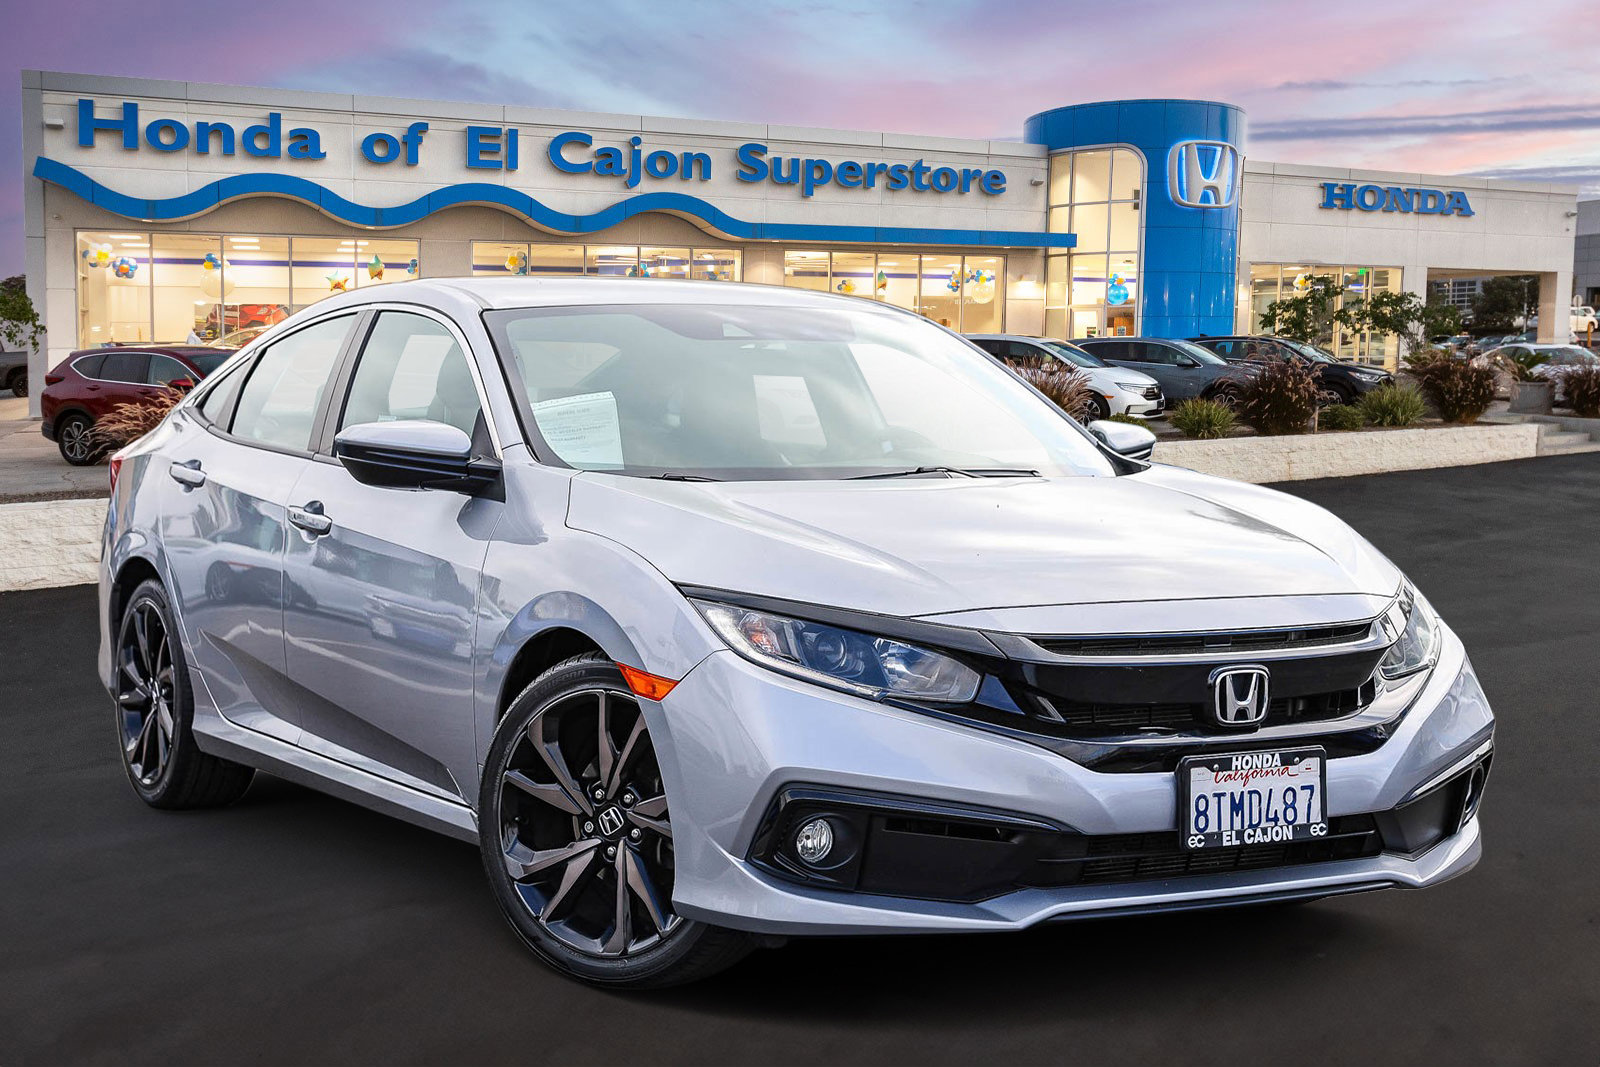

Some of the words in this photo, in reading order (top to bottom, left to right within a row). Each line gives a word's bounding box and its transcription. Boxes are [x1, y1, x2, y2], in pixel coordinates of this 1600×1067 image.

[78, 98, 327, 161] Honda
[361, 121, 429, 166] of
[466, 125, 519, 170] El
[547, 131, 712, 190] Cajon
[737, 142, 1008, 197] Superstore
[1319, 181, 1476, 217] HONDA
[1231, 753, 1281, 771] HONDA
[1213, 766, 1299, 788] California
[1194, 784, 1315, 834] 8TMD487
[1222, 831, 1241, 847] EL
[1243, 824, 1294, 845] CAJON
